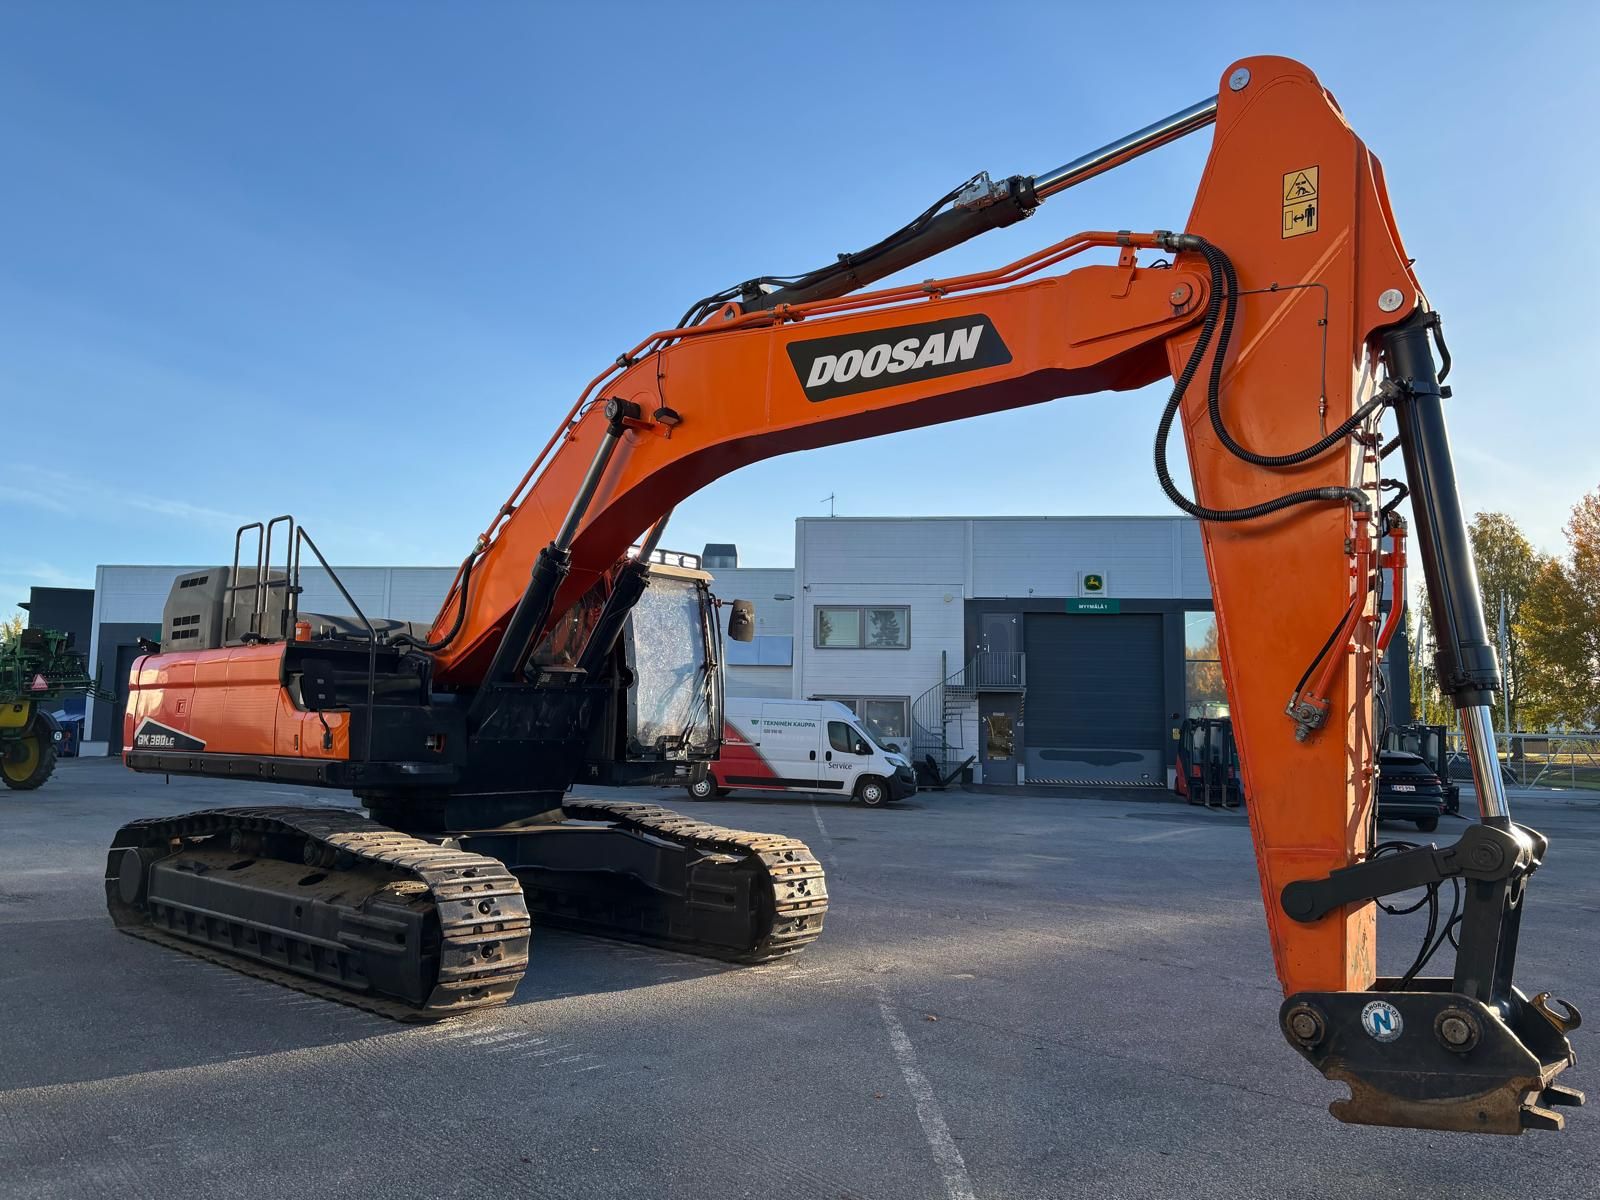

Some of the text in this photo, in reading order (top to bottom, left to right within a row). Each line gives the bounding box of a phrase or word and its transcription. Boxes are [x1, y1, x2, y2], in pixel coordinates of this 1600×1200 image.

[806, 324, 984, 388] DOOSAN
[828, 761, 853, 769] Service
[1368, 1002, 1391, 1010] WORKS
